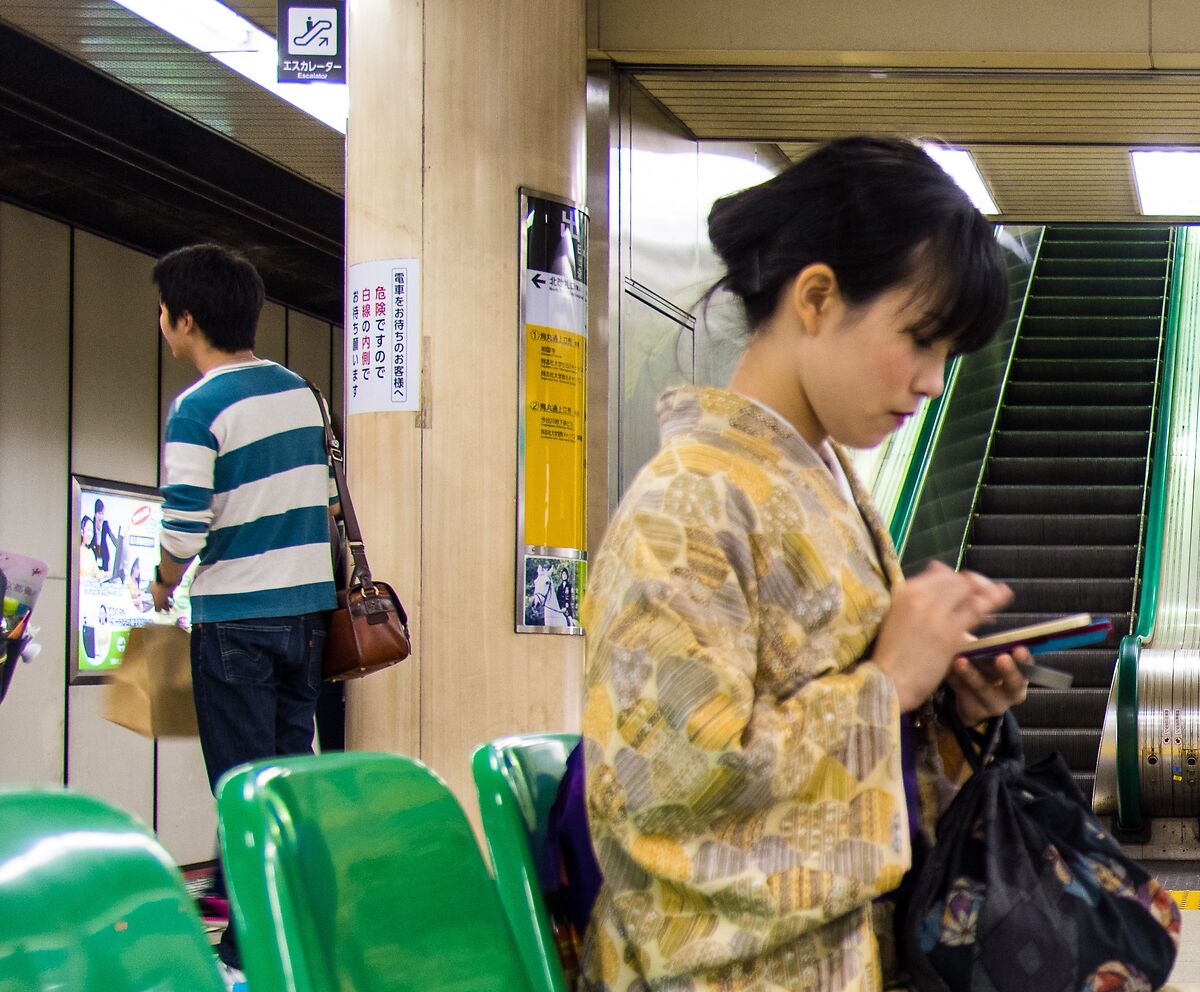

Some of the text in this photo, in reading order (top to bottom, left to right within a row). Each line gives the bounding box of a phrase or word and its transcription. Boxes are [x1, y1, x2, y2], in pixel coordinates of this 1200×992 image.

[283, 61, 342, 72] エスカレーター
[361, 288, 371, 381] 白線の内側で
[375, 286, 386, 379] 危険ですので
[393, 272, 405, 397] 電車をお待ちのお客様へ
